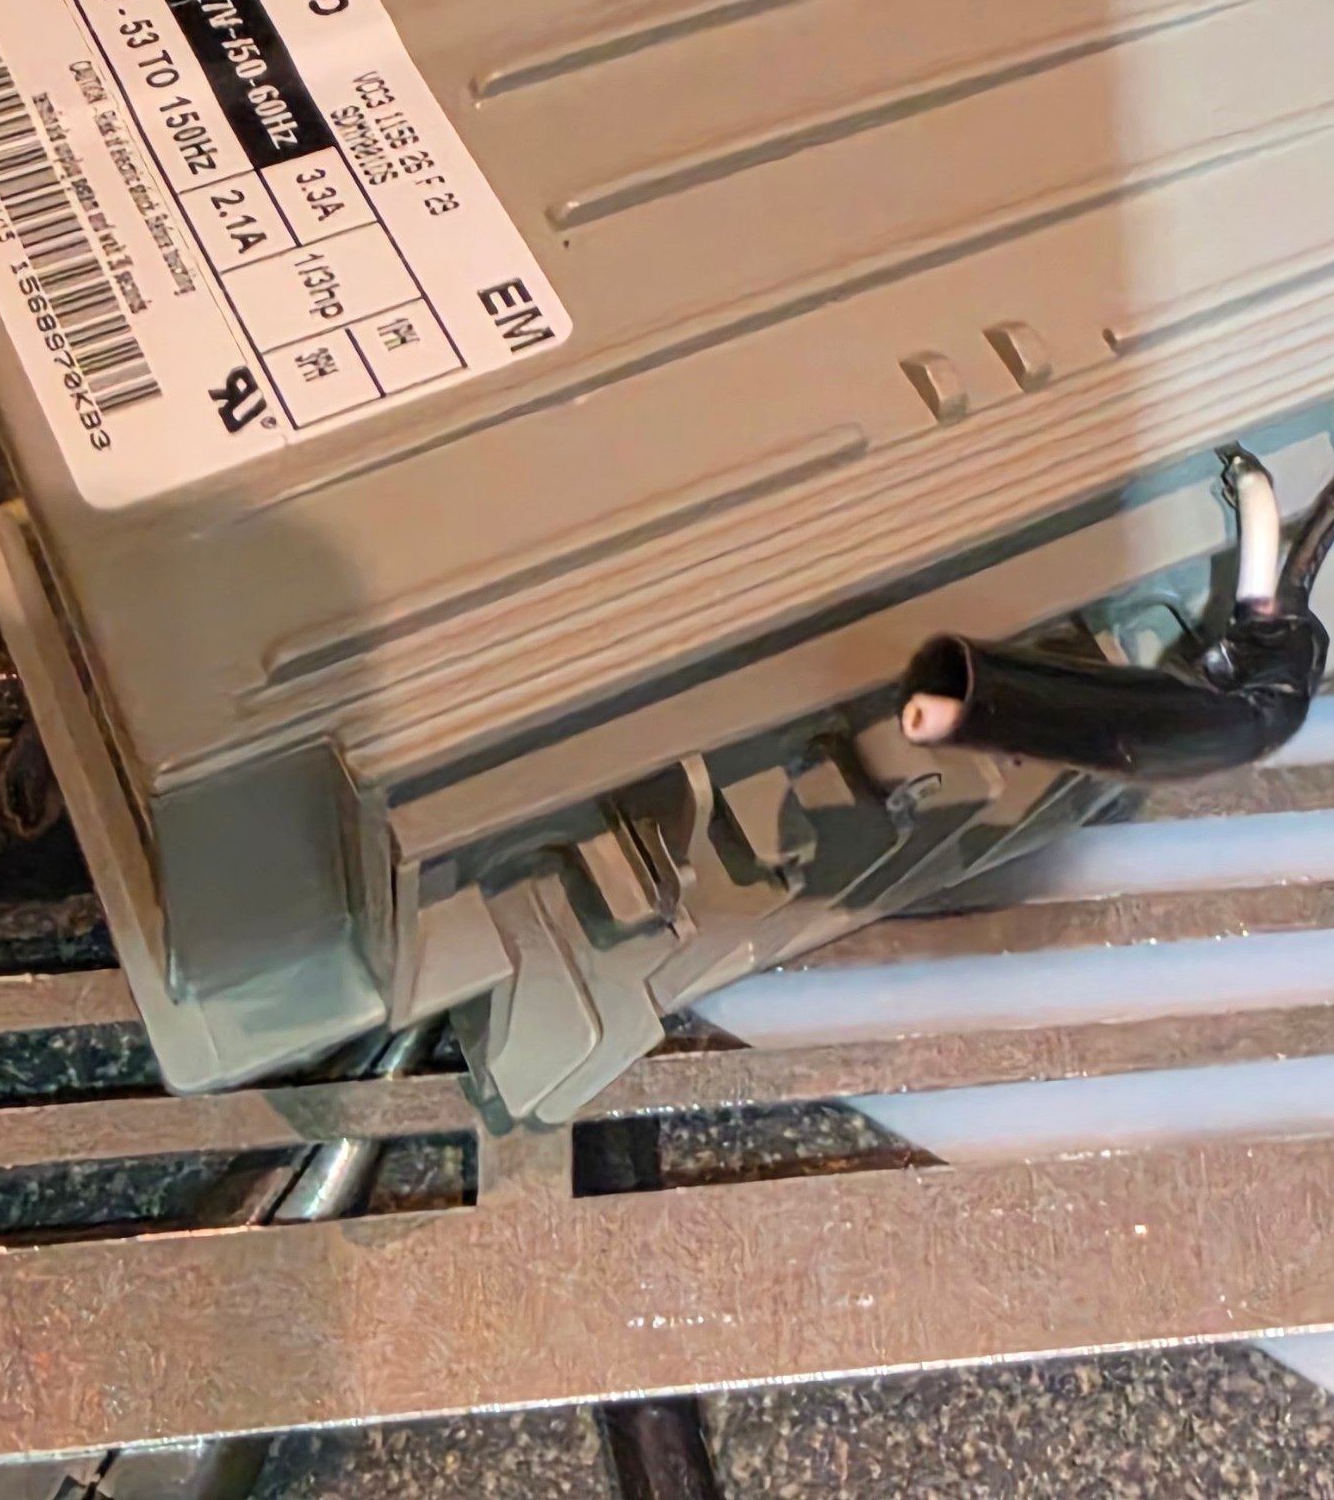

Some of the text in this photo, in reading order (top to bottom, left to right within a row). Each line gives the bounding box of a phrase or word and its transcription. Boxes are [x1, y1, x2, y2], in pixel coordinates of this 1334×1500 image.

[120, 20, 159, 48] 53
[138, 50, 179, 88] TO
[160, 97, 217, 175] 150Hz
[211, 190, 267, 254] 2.1A
[296, 169, 344, 221] 3.3A
[295, 254, 343, 319] 1/3hp
[477, 278, 555, 353] EM
[11, 258, 110, 451] 1568970KB3
